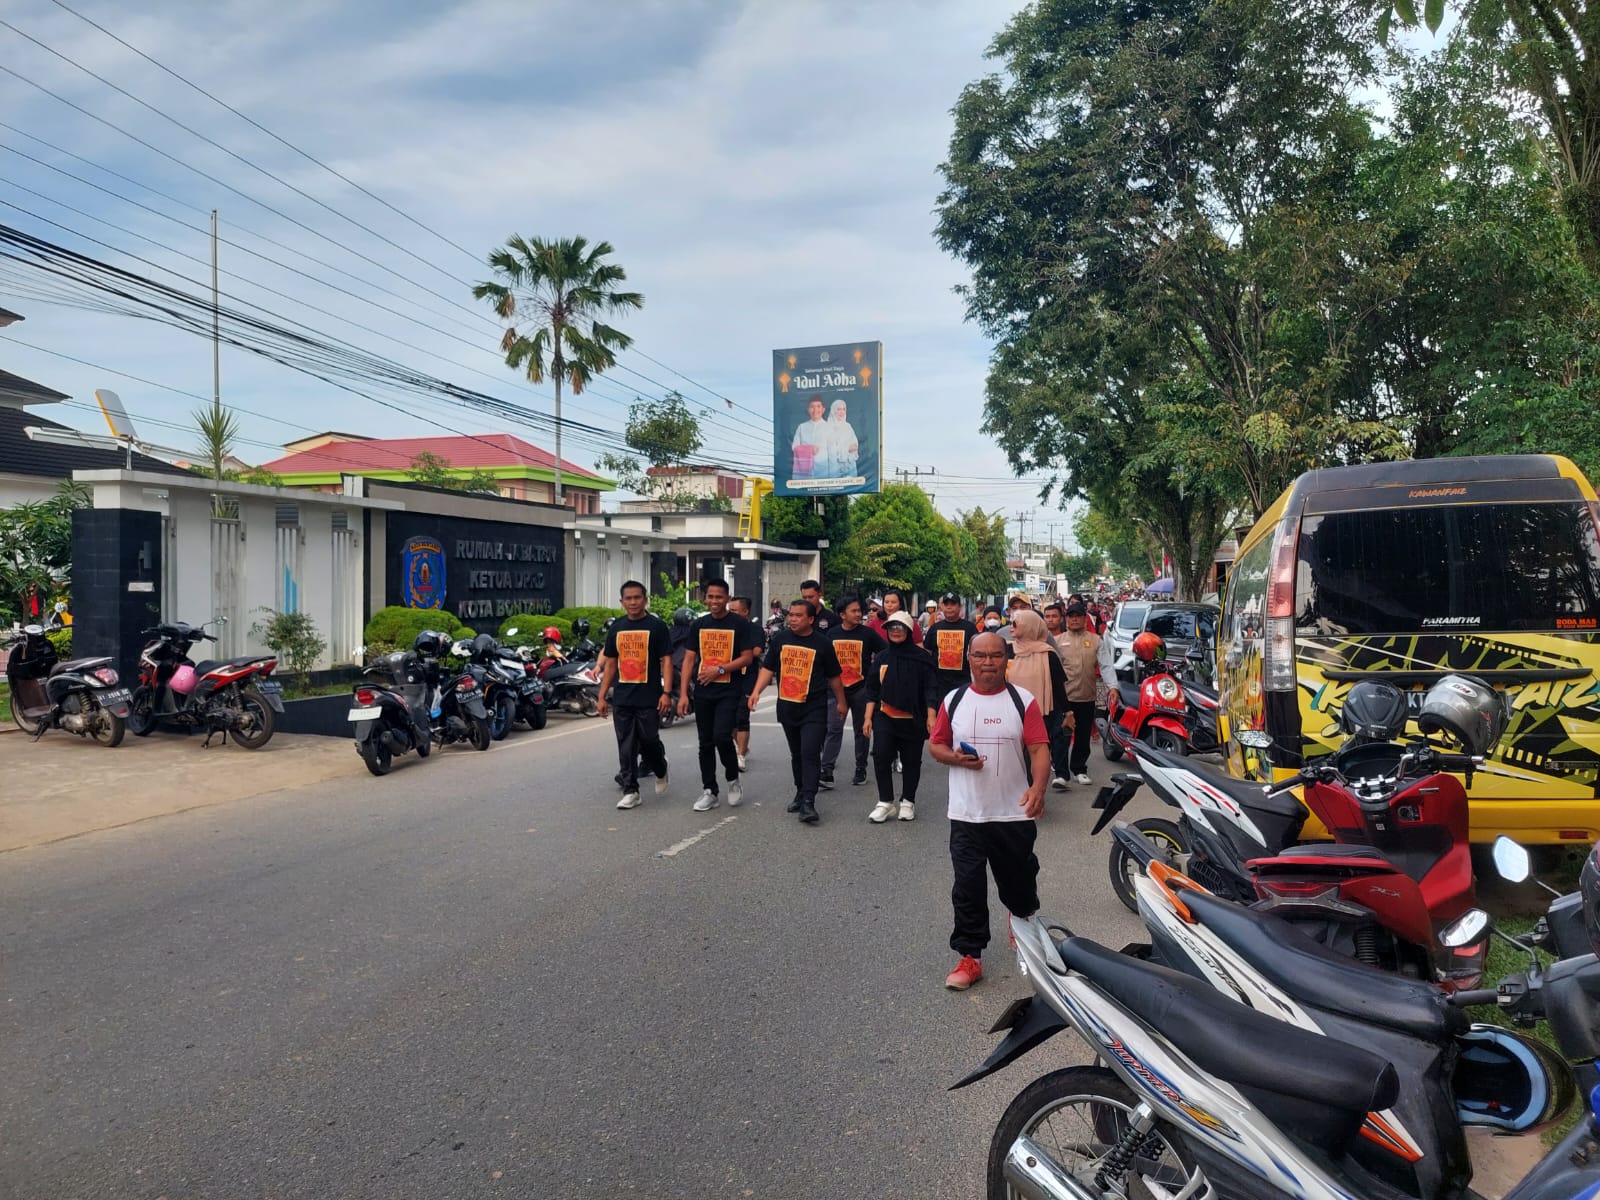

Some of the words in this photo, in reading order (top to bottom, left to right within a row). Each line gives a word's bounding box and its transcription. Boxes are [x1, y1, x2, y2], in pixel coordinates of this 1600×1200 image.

[793, 374, 820, 389] Idul
[821, 372, 857, 388] Adha
[455, 539, 504, 560] RUMAH
[505, 543, 557, 563] JABATAN
[469, 570, 512, 589] KETUA
[516, 572, 545, 589] DPRD
[458, 600, 494, 618] KOTA
[496, 598, 552, 617] BONTANG
[1422, 616, 1480, 625] PARAMITRA
